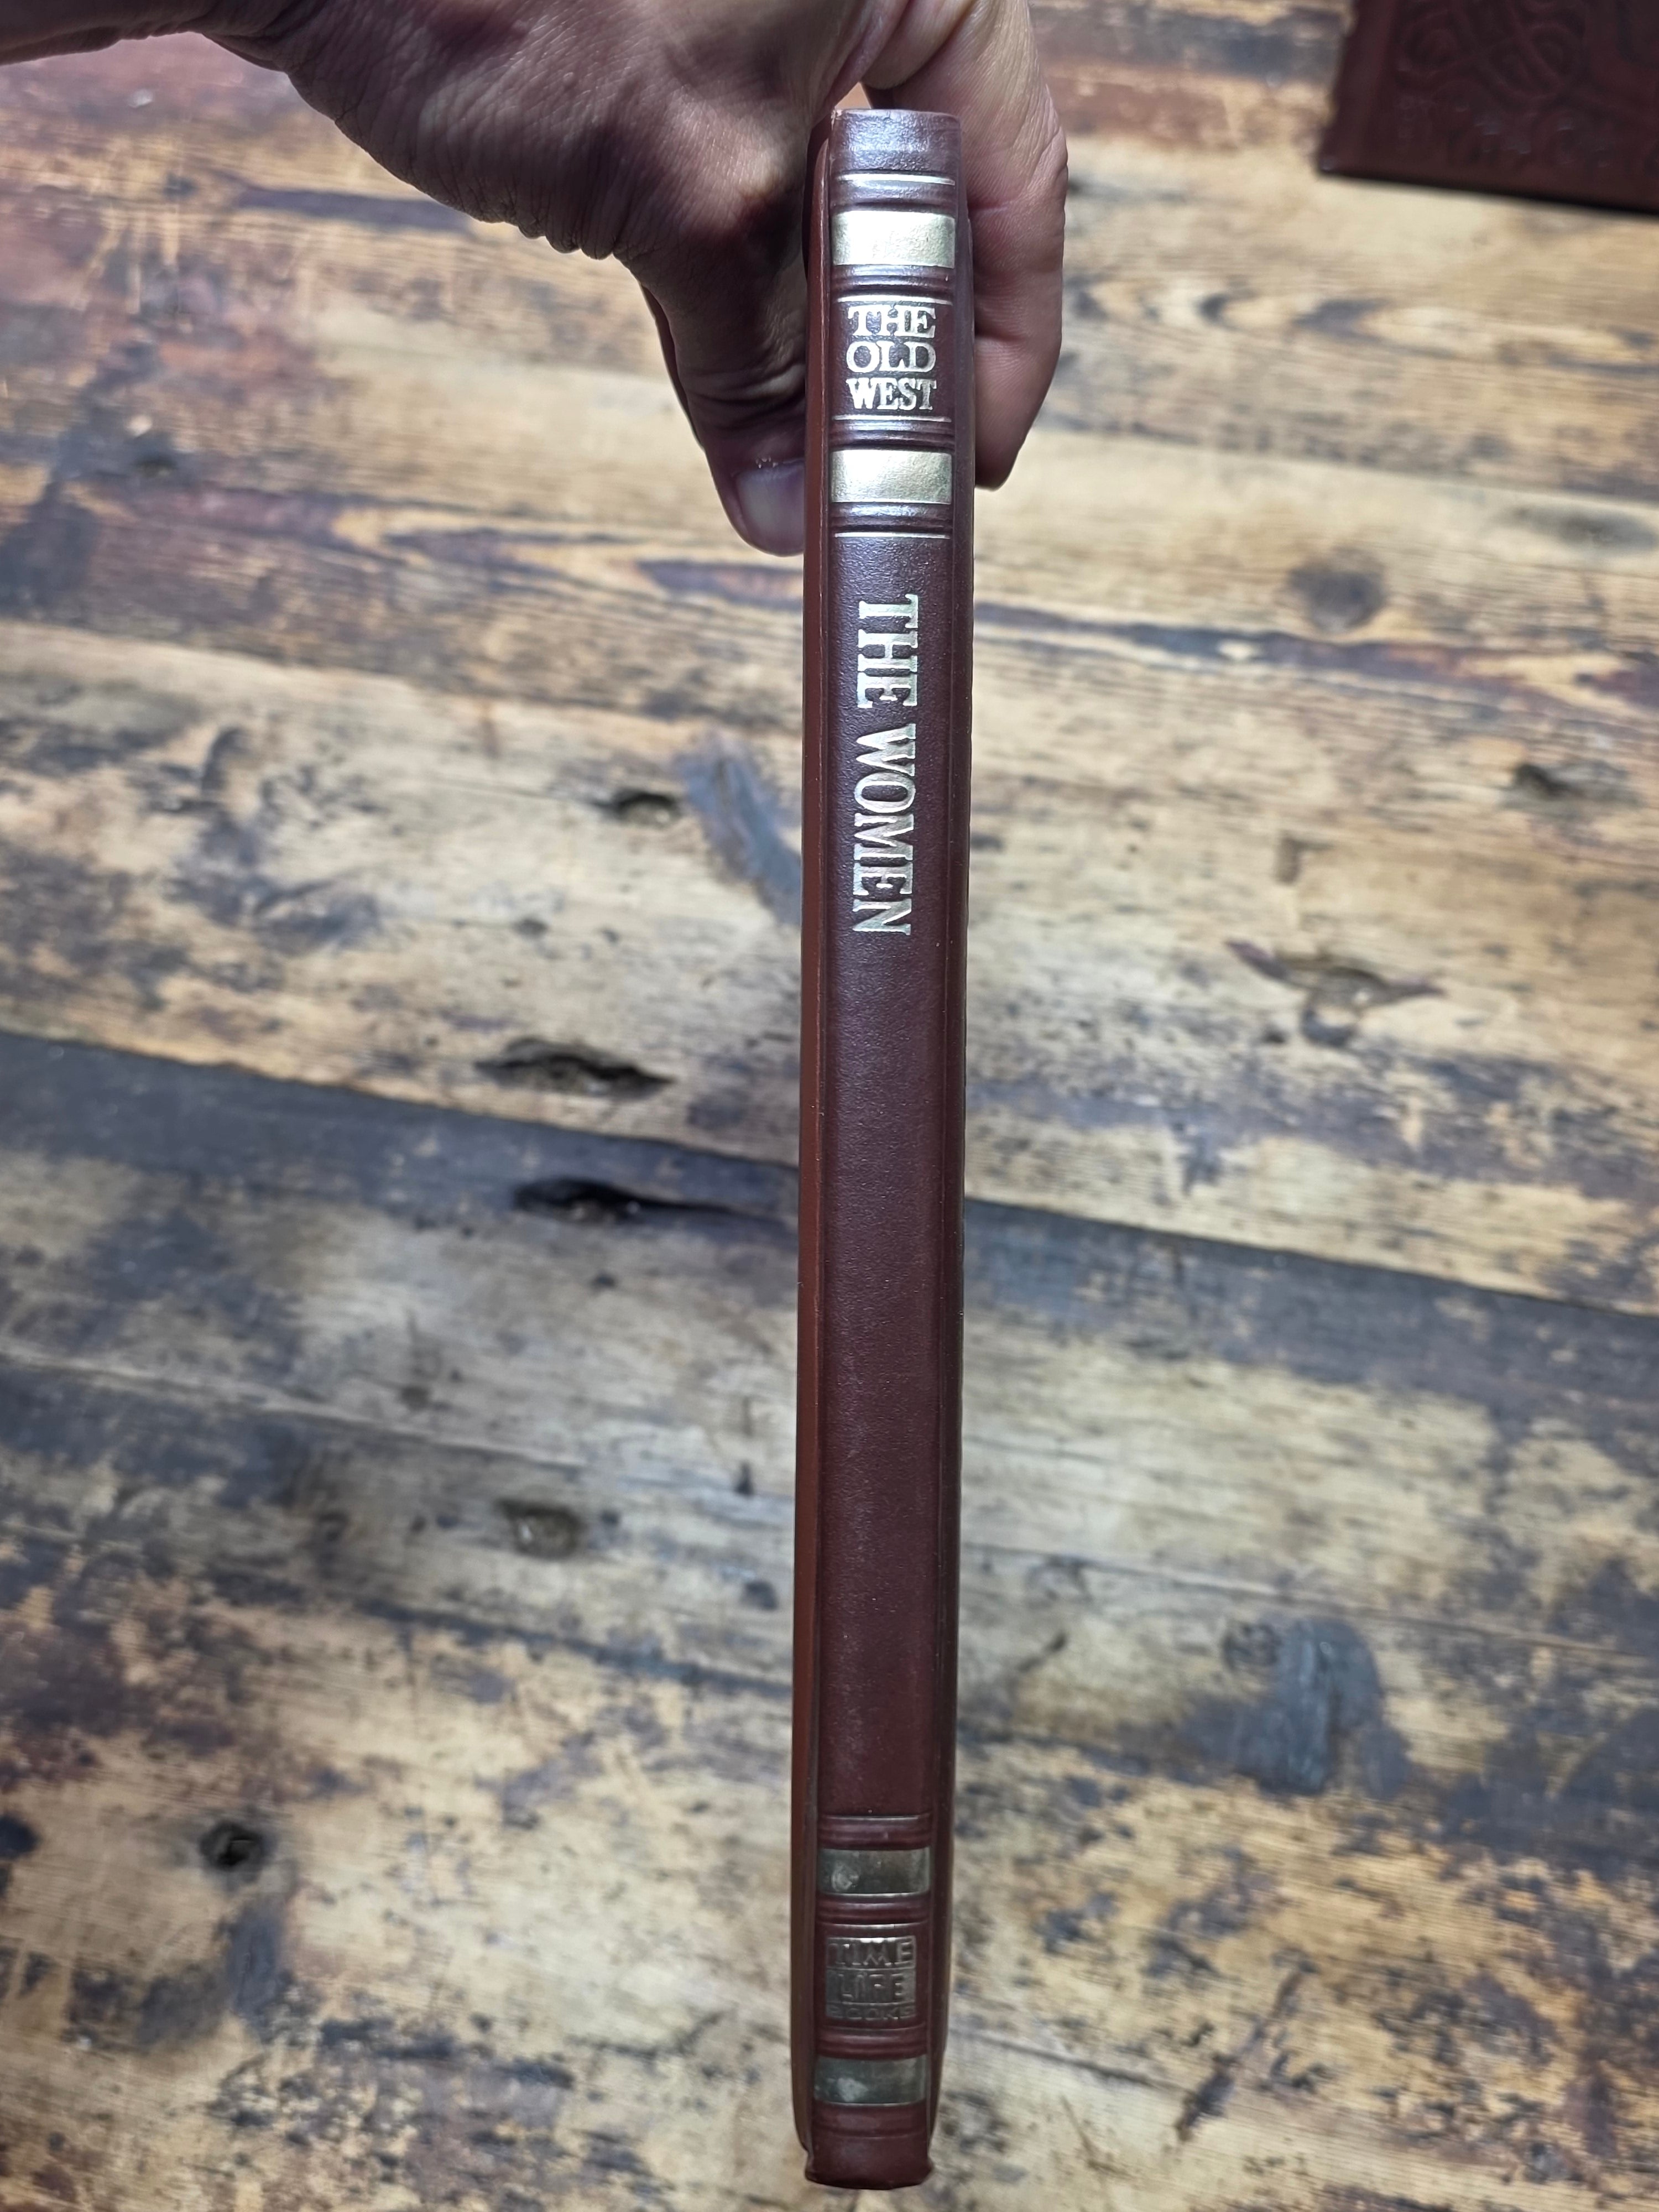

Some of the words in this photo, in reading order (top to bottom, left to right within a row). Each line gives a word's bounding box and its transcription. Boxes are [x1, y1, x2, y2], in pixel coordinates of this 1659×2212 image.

[847, 304, 936, 338] THE
[846, 341, 936, 373] OLD
[846, 377, 937, 410] WEST
[857, 594, 919, 708] THE
[852, 723, 916, 936] WOMEN
[828, 1940, 913, 1966] TIME
[834, 1972, 909, 2001] LIFE
